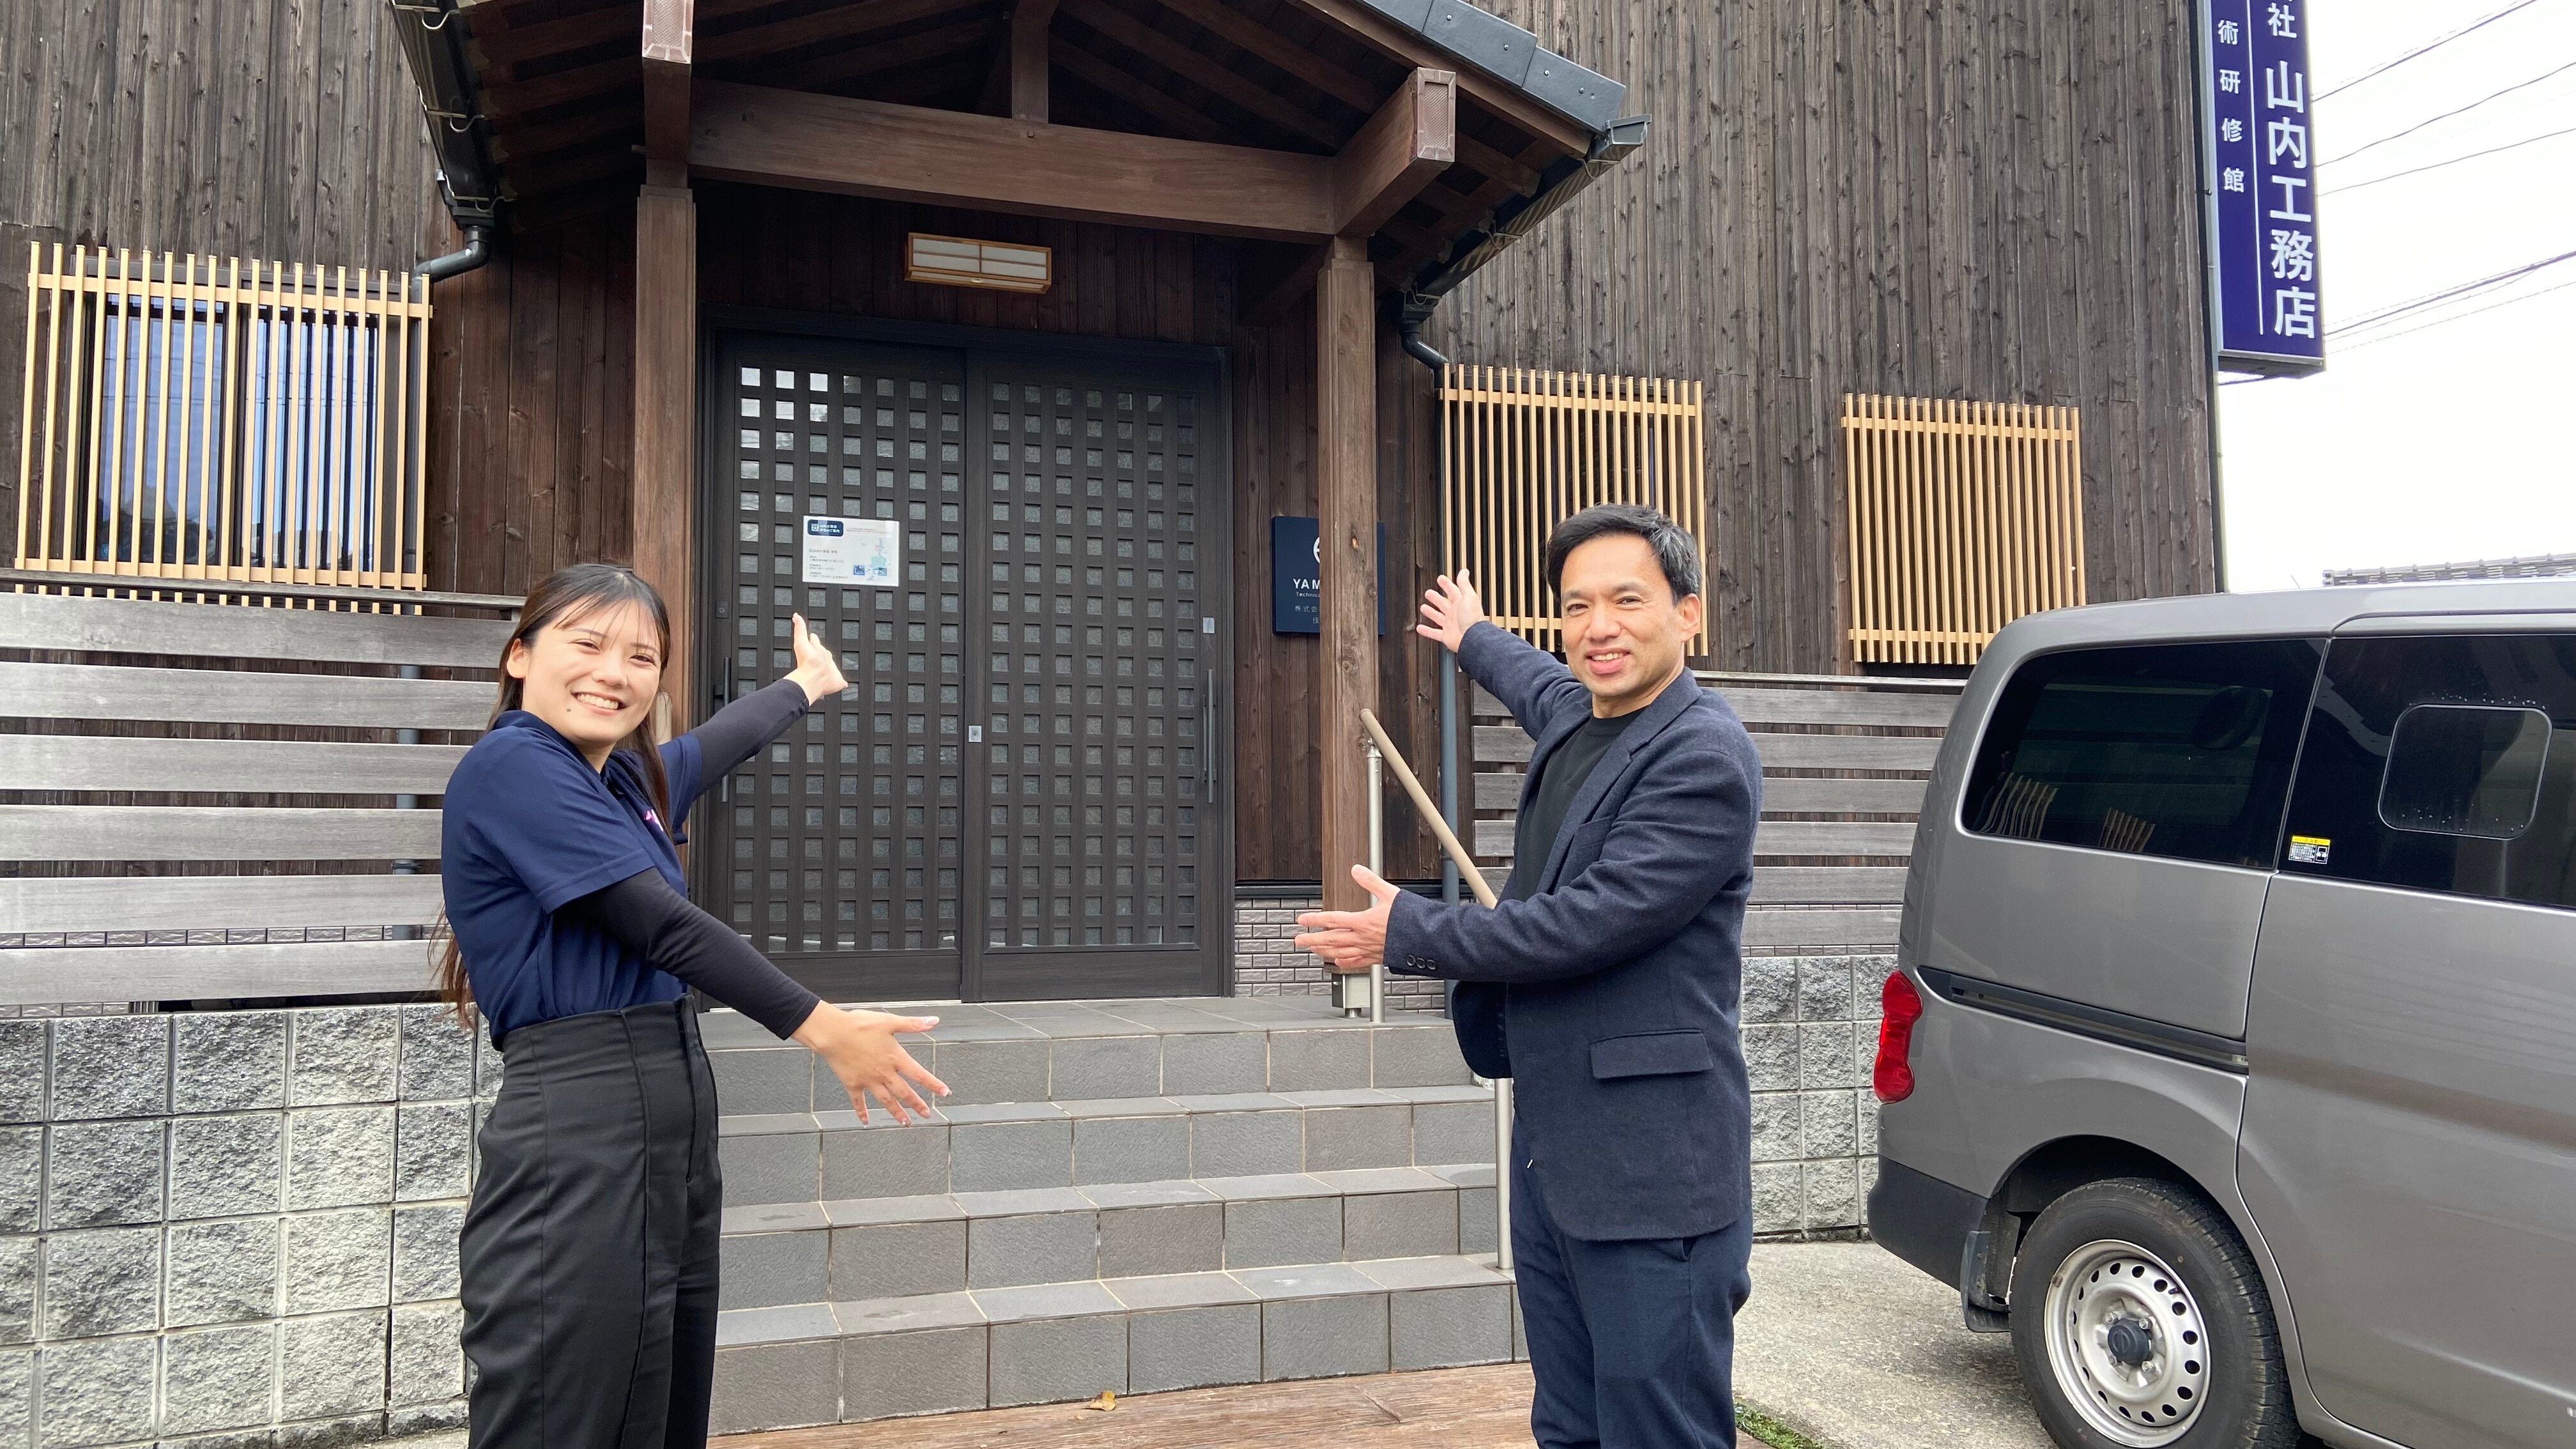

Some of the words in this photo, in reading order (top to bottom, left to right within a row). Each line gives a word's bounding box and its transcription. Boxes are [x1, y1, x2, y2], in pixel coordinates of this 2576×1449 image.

[2266, 60, 2315, 339] 山内工務店
